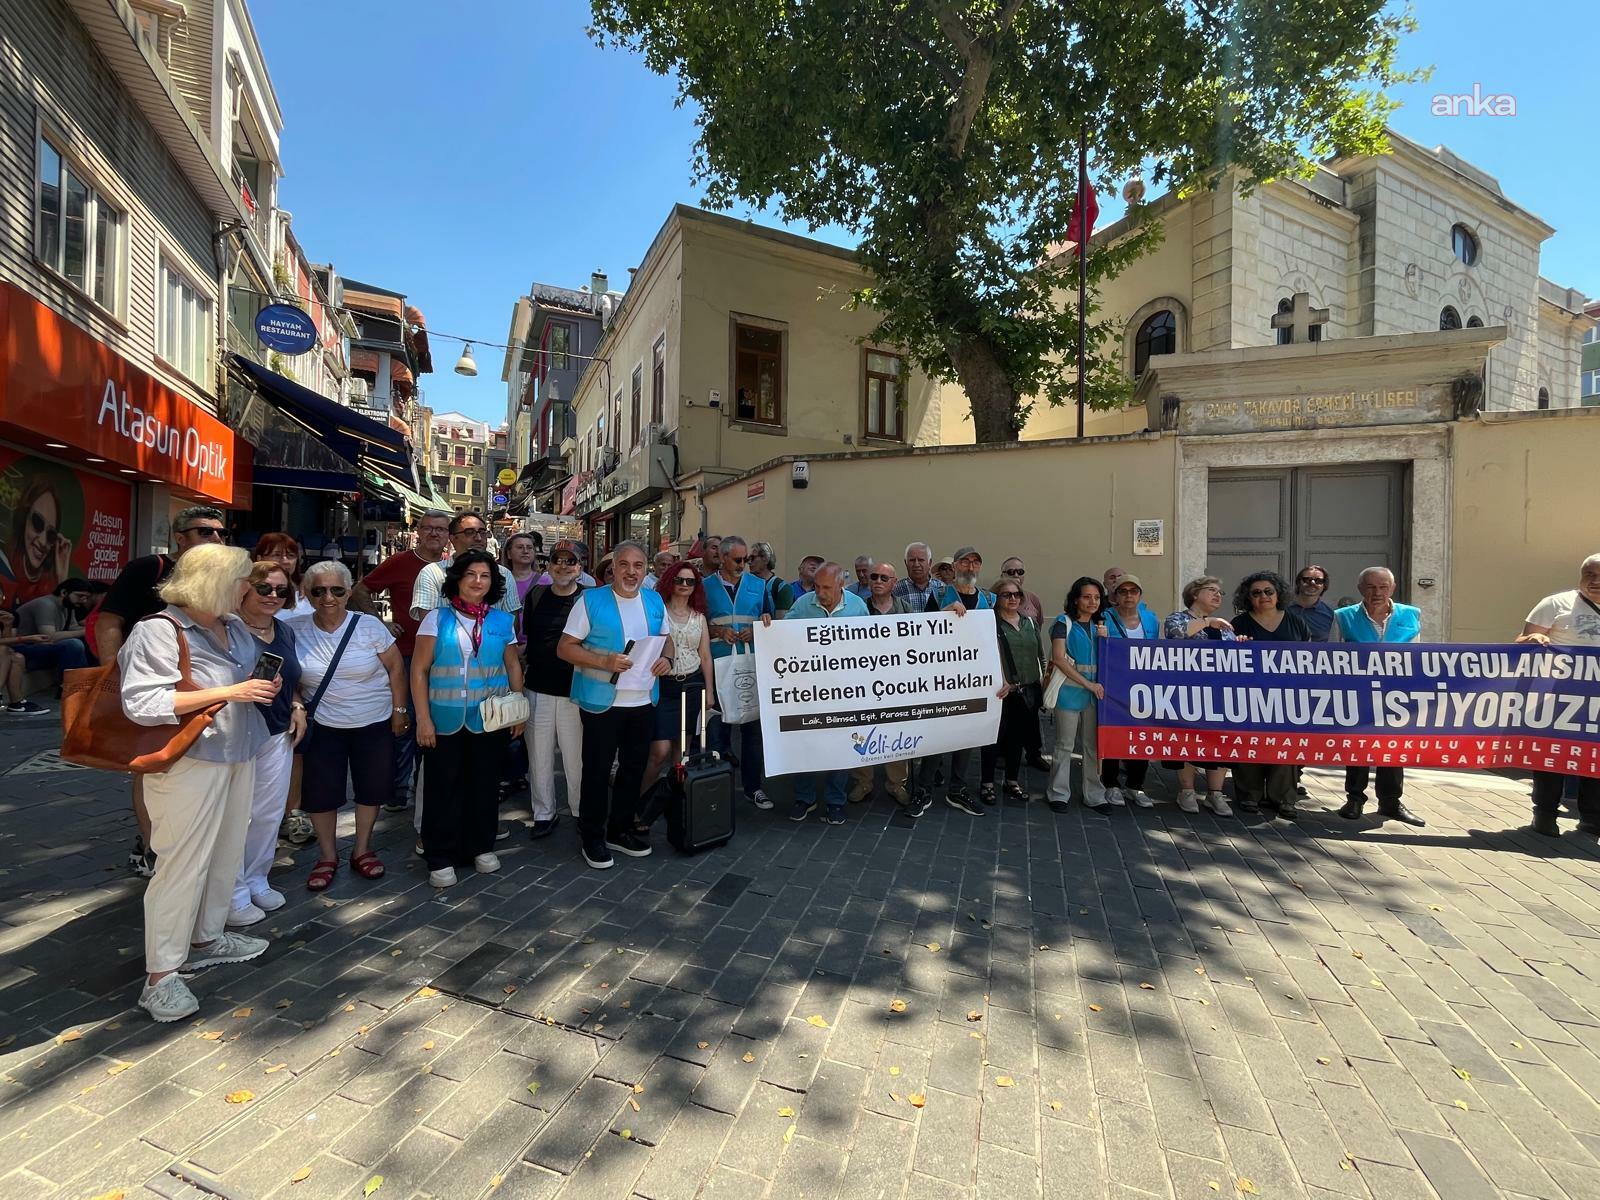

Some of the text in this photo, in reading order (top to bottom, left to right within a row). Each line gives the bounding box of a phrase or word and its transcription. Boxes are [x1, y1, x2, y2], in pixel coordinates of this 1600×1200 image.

[260, 325, 311, 339] RESTAURANT
[270, 320, 302, 331] HAYYAM
[97, 379, 227, 480] Atasun Optik
[92, 510, 123, 529] Atasun
[87, 527, 126, 549] gözünde
[94, 545, 119, 564] gözler
[806, 619, 954, 645] Eğitimde Bir Yıl:
[773, 646, 979, 679] Çözülemeyen Sorunlar
[1129, 646, 1600, 682] MAHKEME KARARLARI UYGULANSIN
[771, 673, 993, 704] Ertelenen Çocuk Hakları
[802, 717, 822, 725] Laik,
[860, 713, 878, 722] Eşit,
[880, 710, 910, 719] Parasız
[911, 707, 934, 719] Eğitim
[1129, 681, 1600, 734] OKULUMUZU İSTİYORUZ!
[1129, 731, 1597, 758] İSMAİL TARMAN ORTAOKULU VELİLERİ
[1129, 745, 1596, 773] KONAKLAR MAHALLESİ SAKİNLERİ
